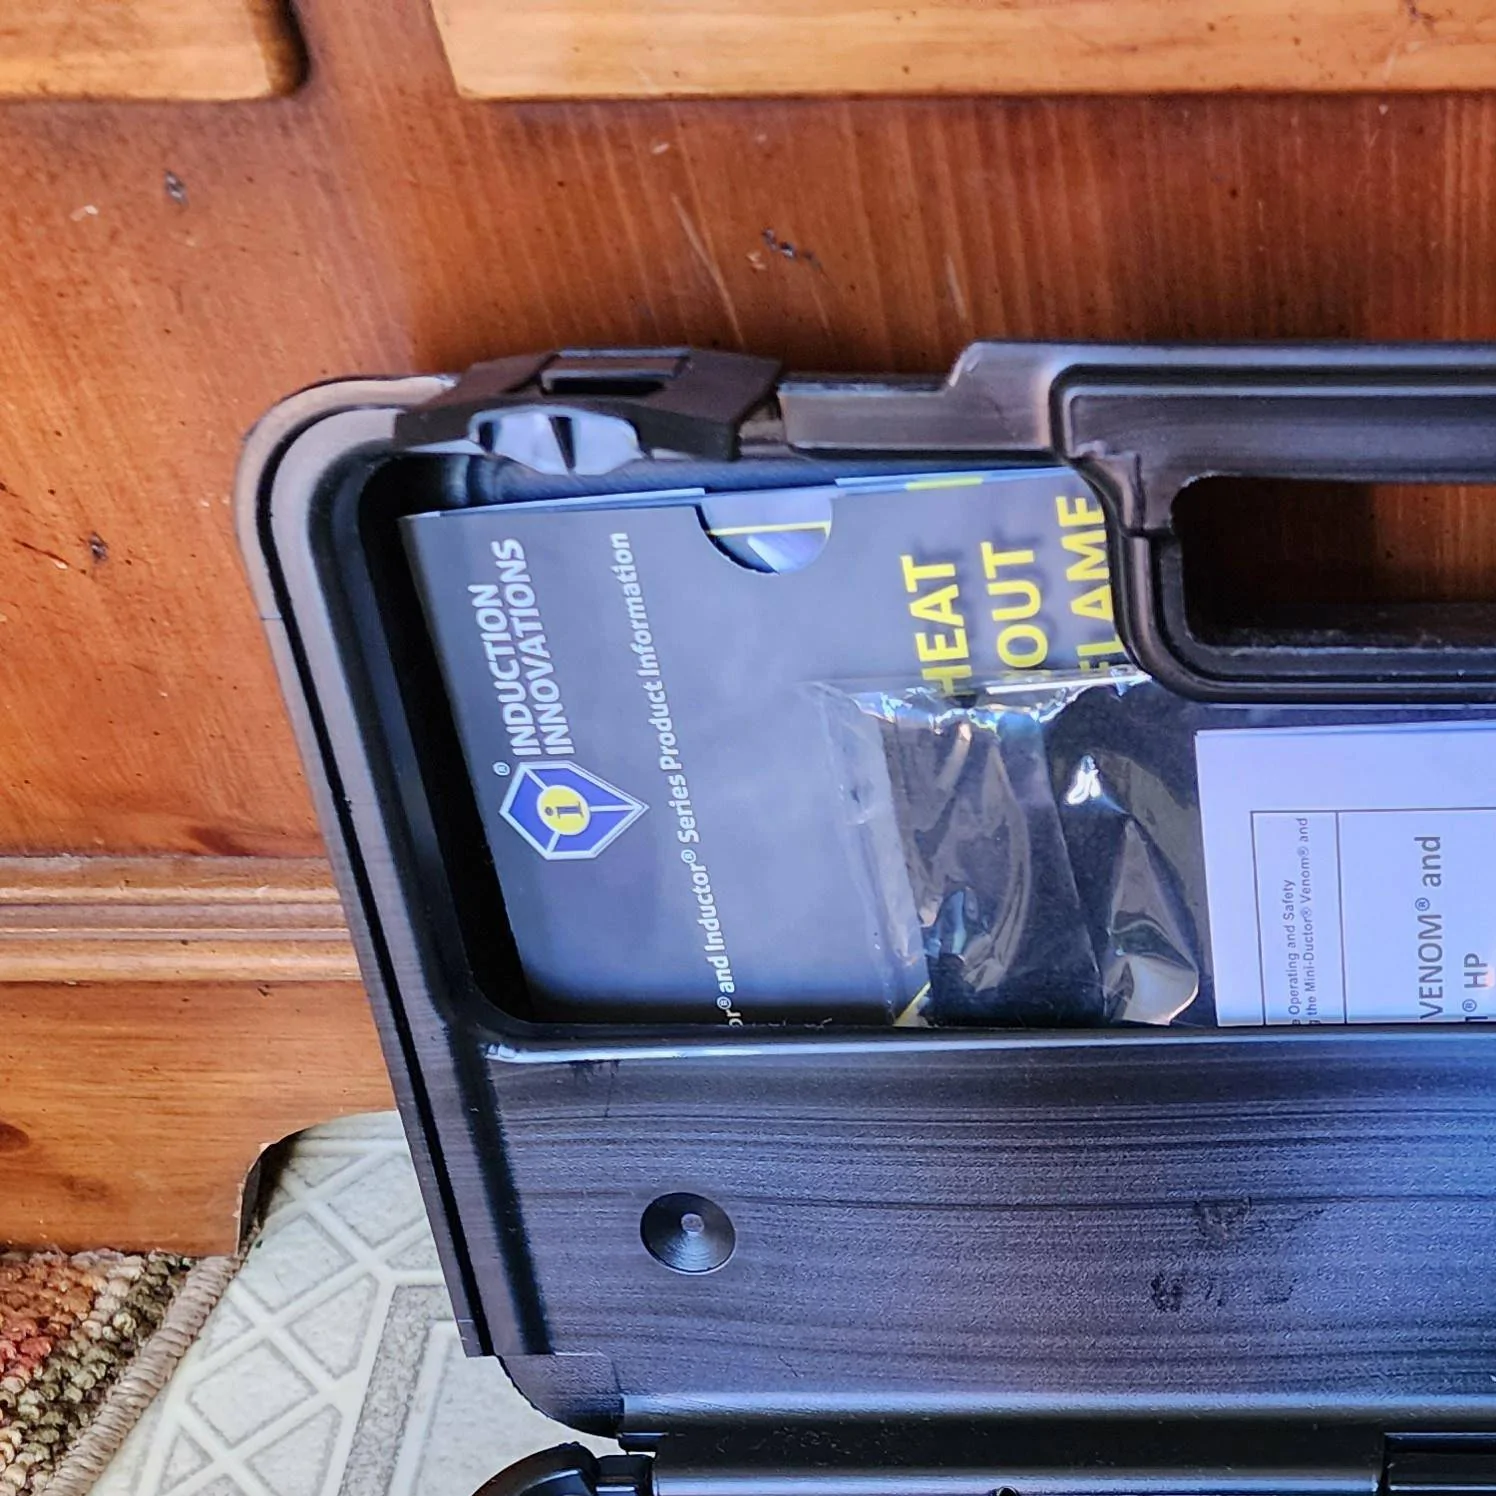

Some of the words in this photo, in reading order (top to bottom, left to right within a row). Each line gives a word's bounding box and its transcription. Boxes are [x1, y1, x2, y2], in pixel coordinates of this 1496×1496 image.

[610, 533, 659, 678] Information
[980, 541, 1048, 676] OUT
[468, 584, 541, 756] INDUCTION
[491, 538, 575, 756] INNOVATIONS
[643, 681, 682, 770] Product
[668, 774, 699, 844] Series
[1296, 817, 1309, 842] and
[1414, 836, 1442, 888] and
[1283, 879, 1297, 921] Safety
[1286, 925, 1297, 950] and
[707, 954, 735, 994] and
[1287, 953, 1300, 1016] Operating
[1463, 953, 1488, 989] HP
[1304, 996, 1315, 1016] the
